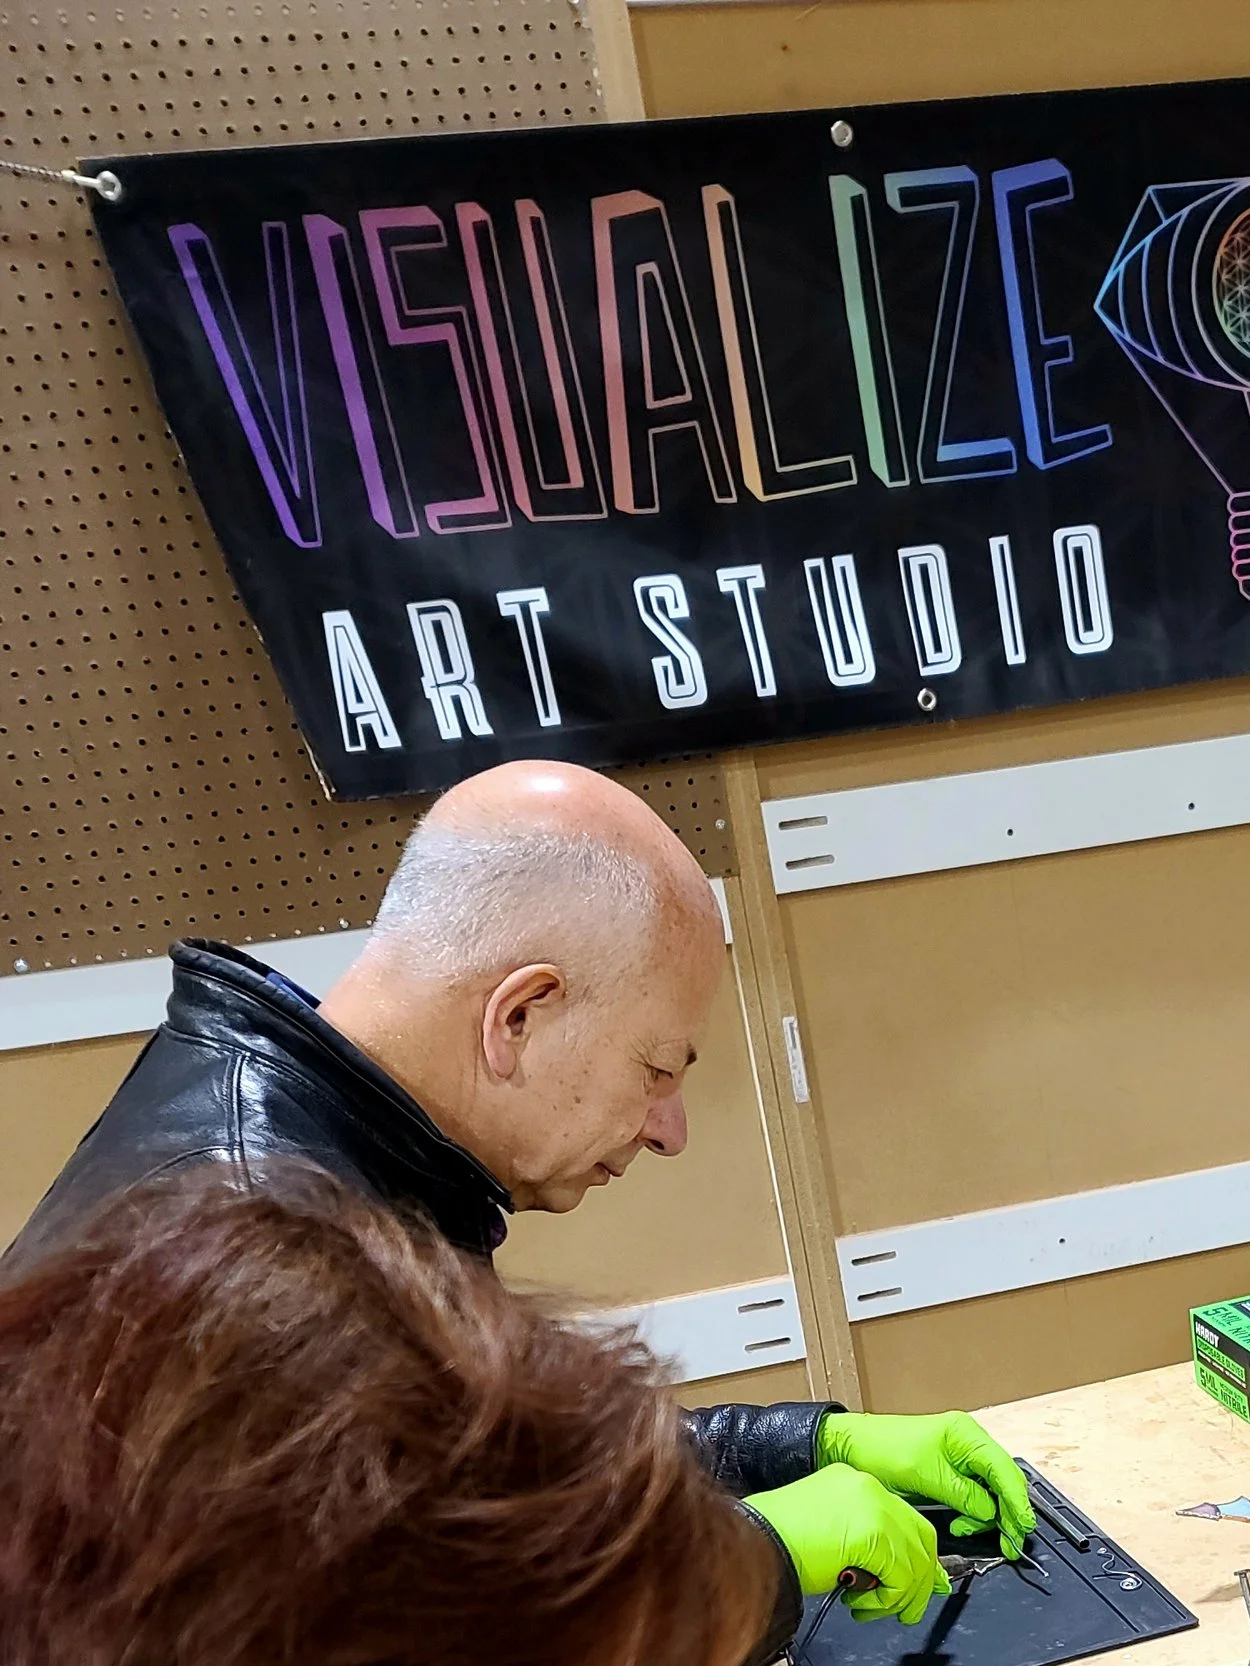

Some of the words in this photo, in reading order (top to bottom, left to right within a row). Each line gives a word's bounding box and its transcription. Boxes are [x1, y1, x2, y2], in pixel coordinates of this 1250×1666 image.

[168, 158, 1113, 548] VISUALIZE
[321, 587, 563, 753] ART
[633, 525, 1112, 713] STUDIO
[1195, 1321, 1219, 1348] HARDY
